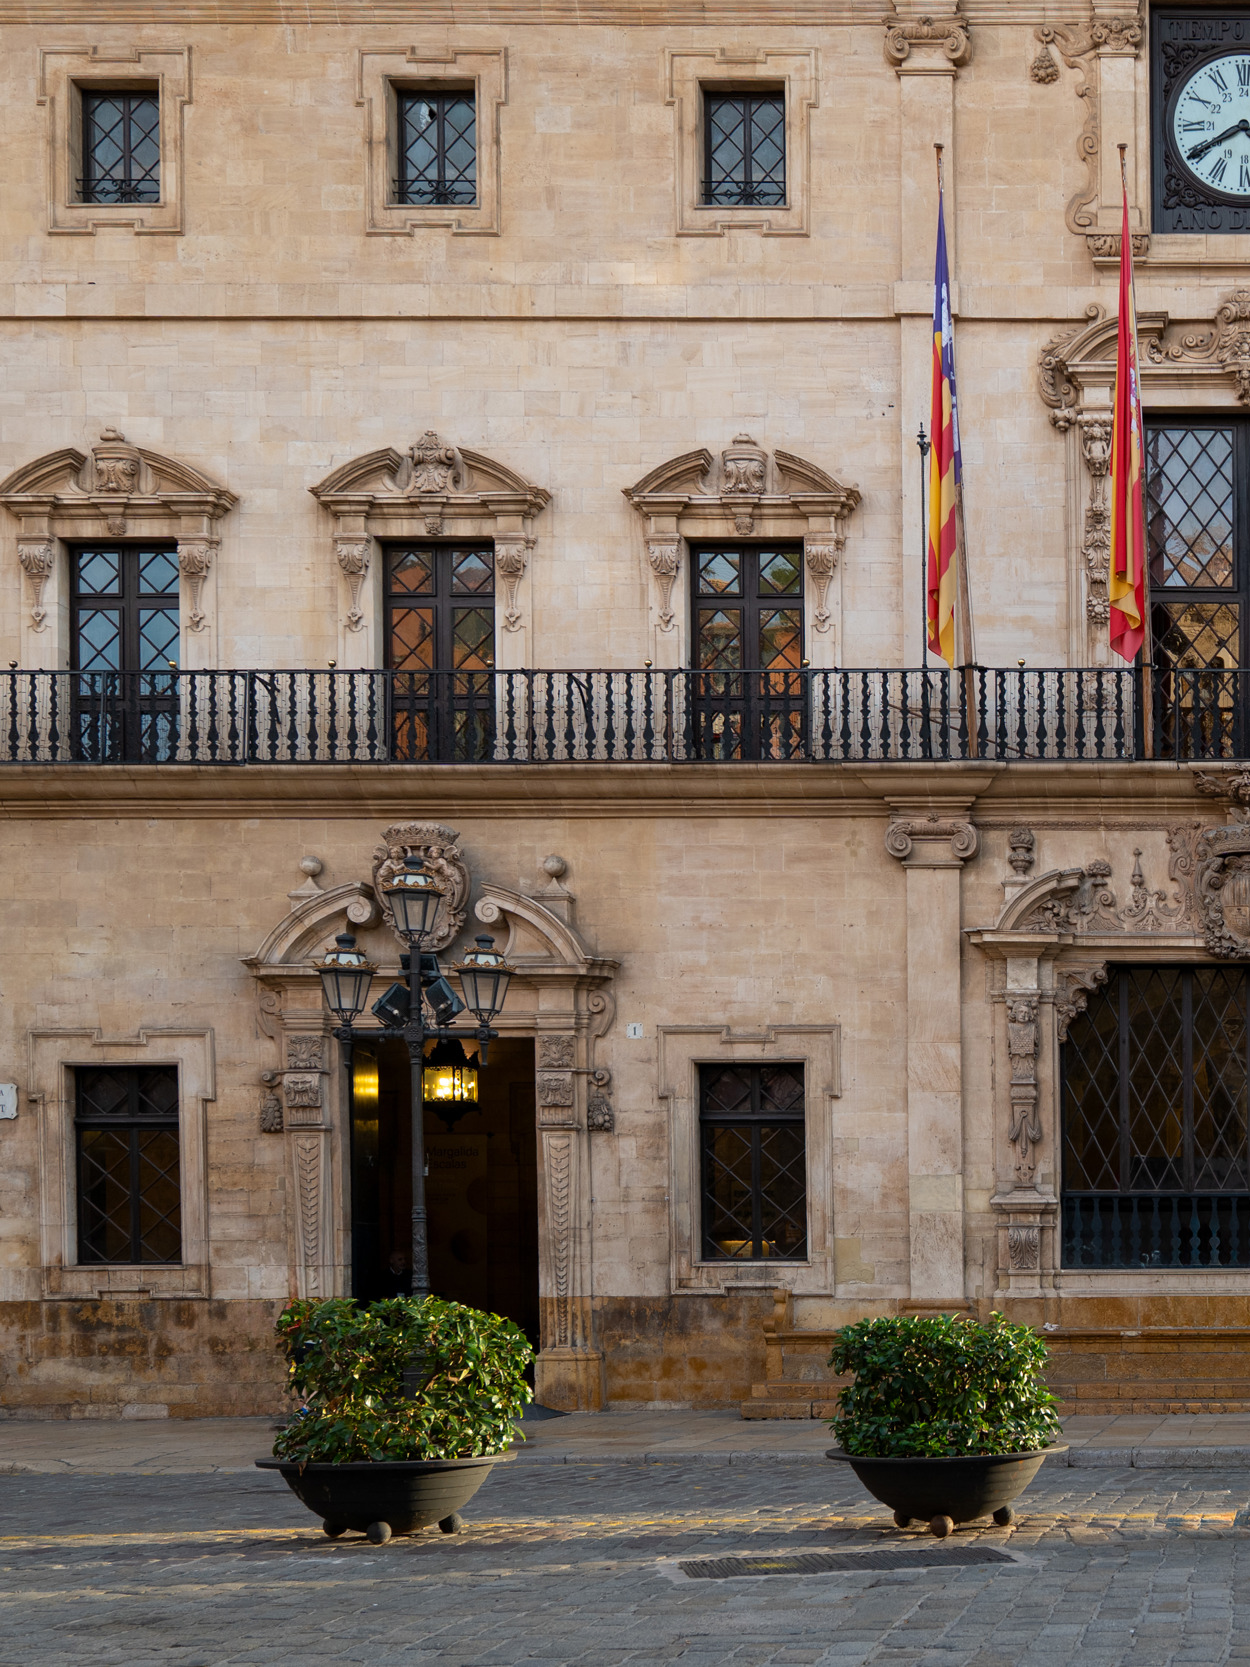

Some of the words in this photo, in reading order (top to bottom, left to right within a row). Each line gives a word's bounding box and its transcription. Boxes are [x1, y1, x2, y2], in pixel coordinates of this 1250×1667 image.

[1169, 21, 1245, 41] TIEMPO
[1222, 92, 1232, 103] 23
[1239, 87, 1249, 98] 24
[1211, 103, 1221, 114] 22
[1206, 121, 1215, 131] 21
[1224, 149, 1233, 159] 19
[1241, 154, 1249, 164] 18
[1172, 207, 1223, 231] AÑO
[425, 1145, 479, 1159] Margalida
